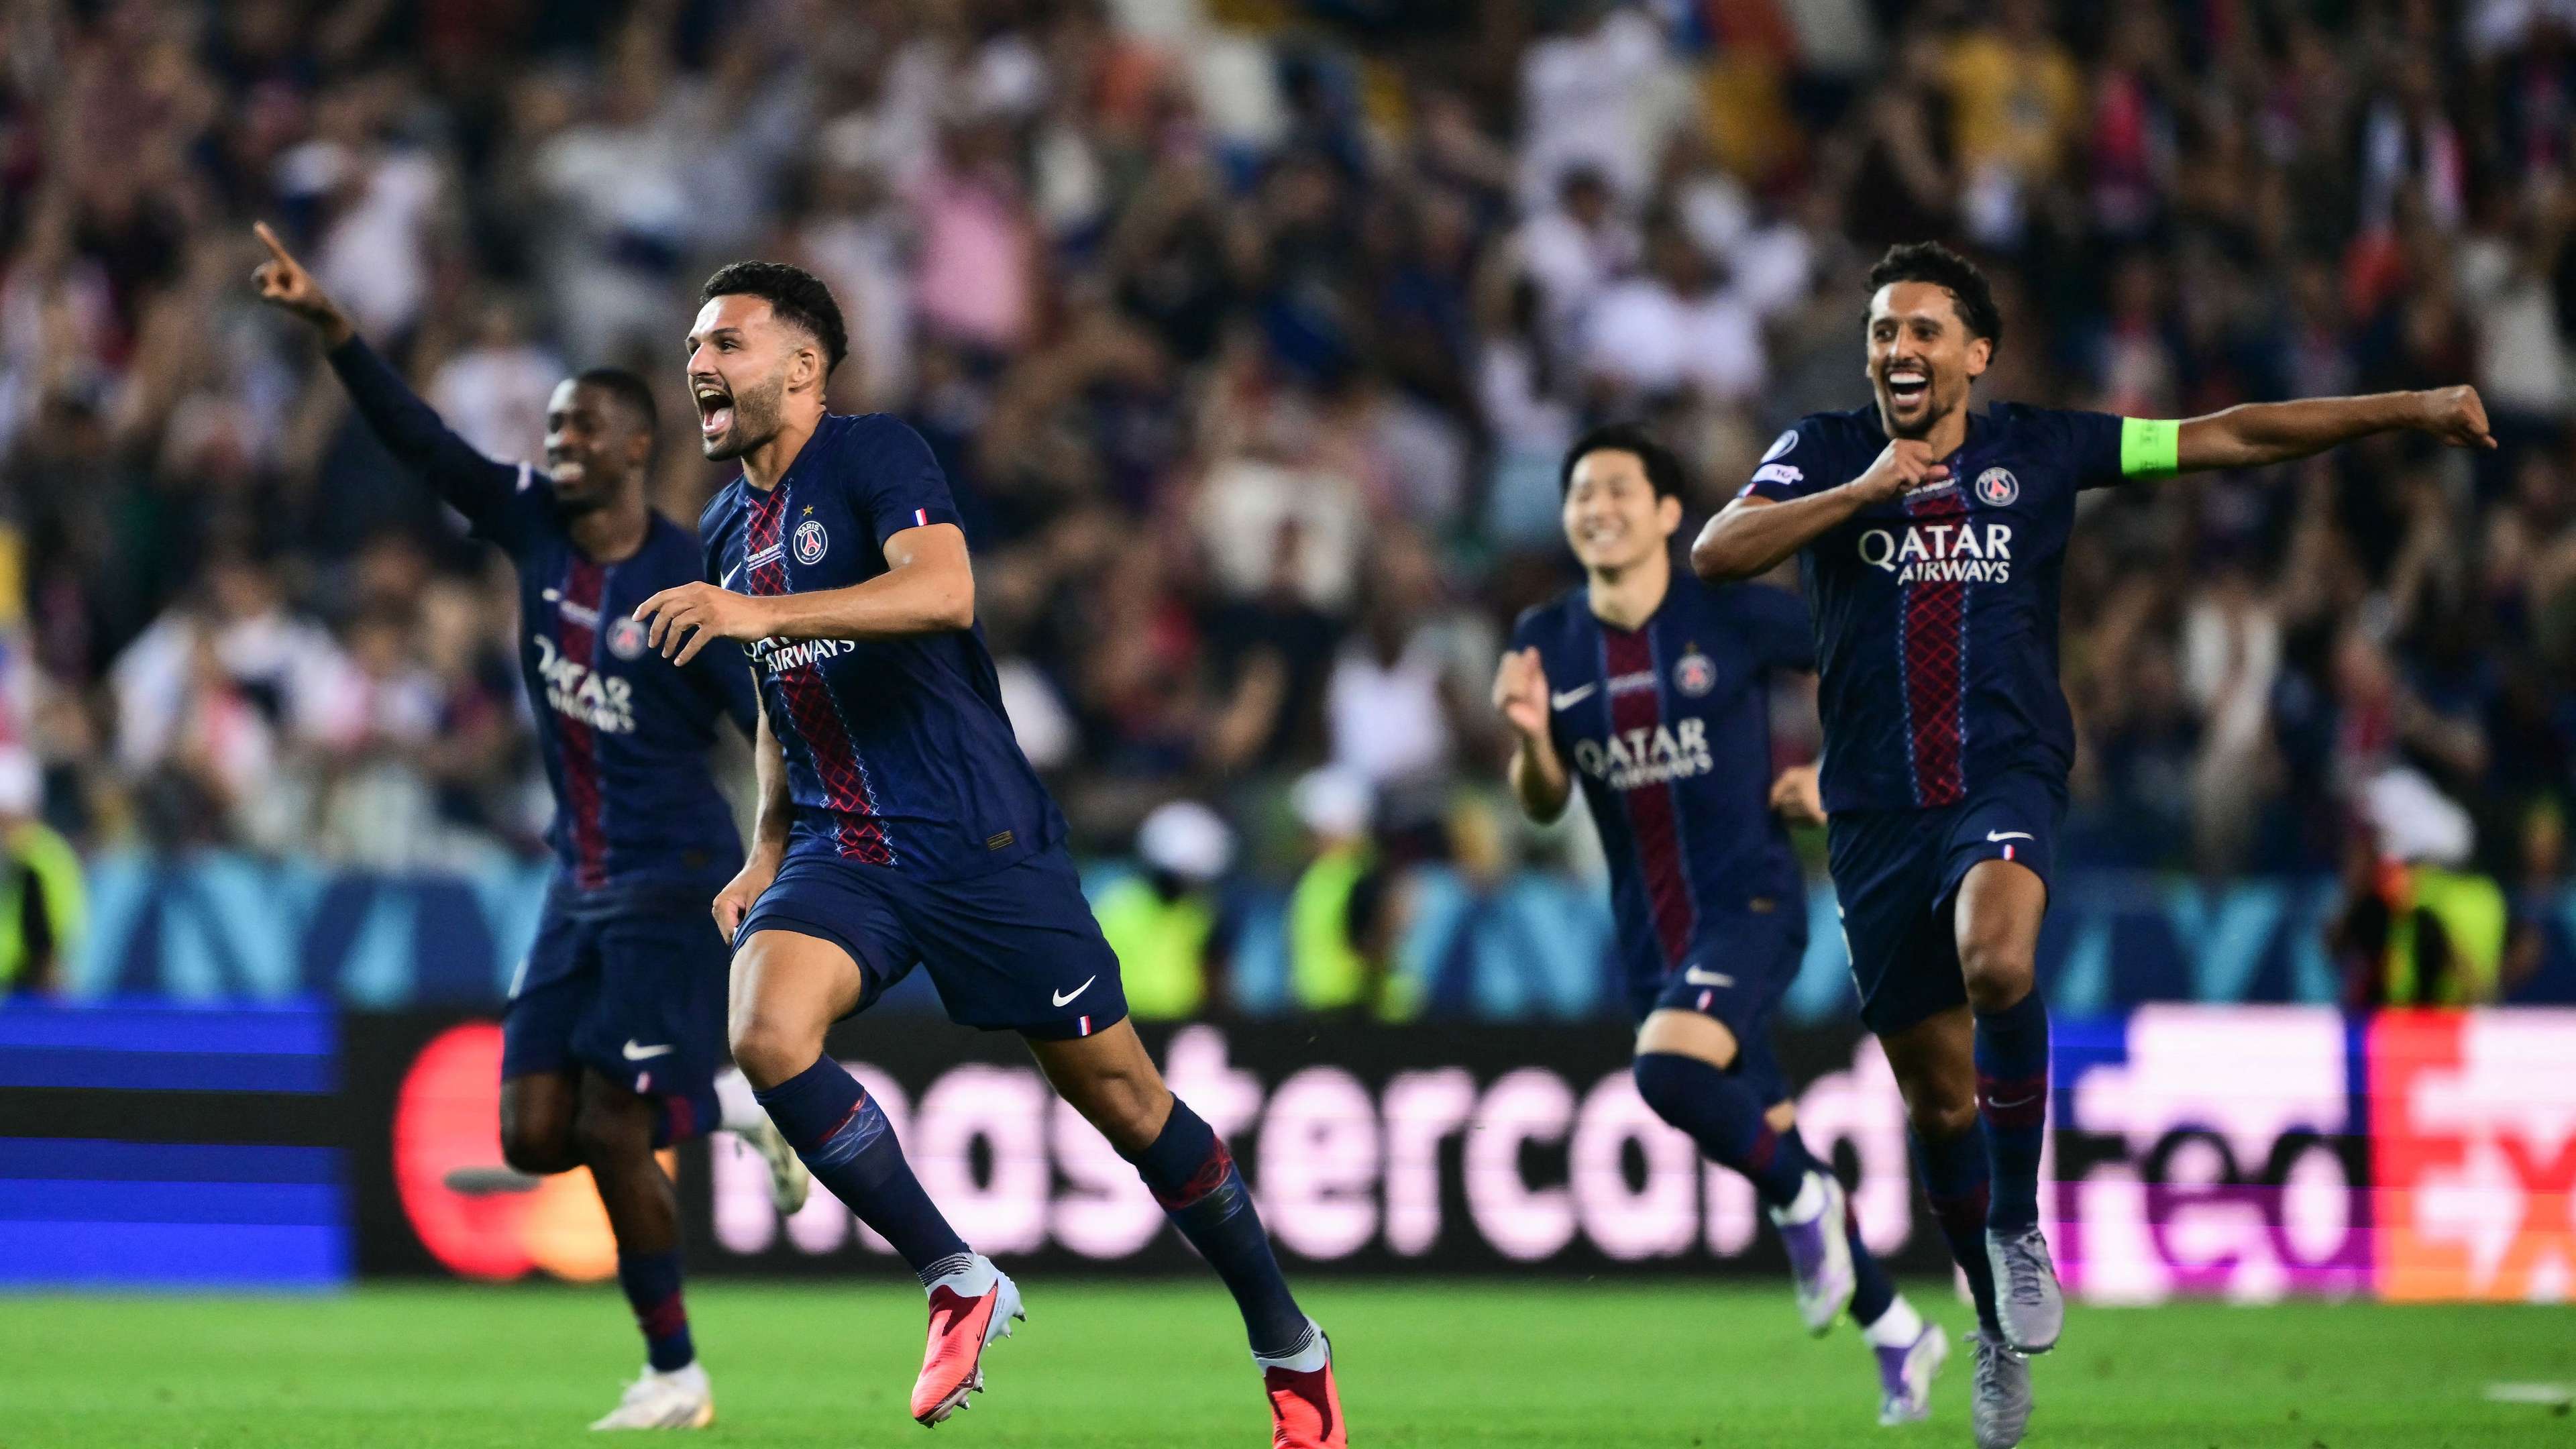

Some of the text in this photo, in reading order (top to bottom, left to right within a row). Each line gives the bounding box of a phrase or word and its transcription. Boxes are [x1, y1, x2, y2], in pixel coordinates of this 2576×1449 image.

[798, 523, 819, 537] PARIS
[1858, 523, 2012, 572] QATAR
[1897, 559, 2010, 586] AIRWAYS
[765, 639, 855, 673] AIRWAYS
[1574, 716, 1709, 781] QATAR
